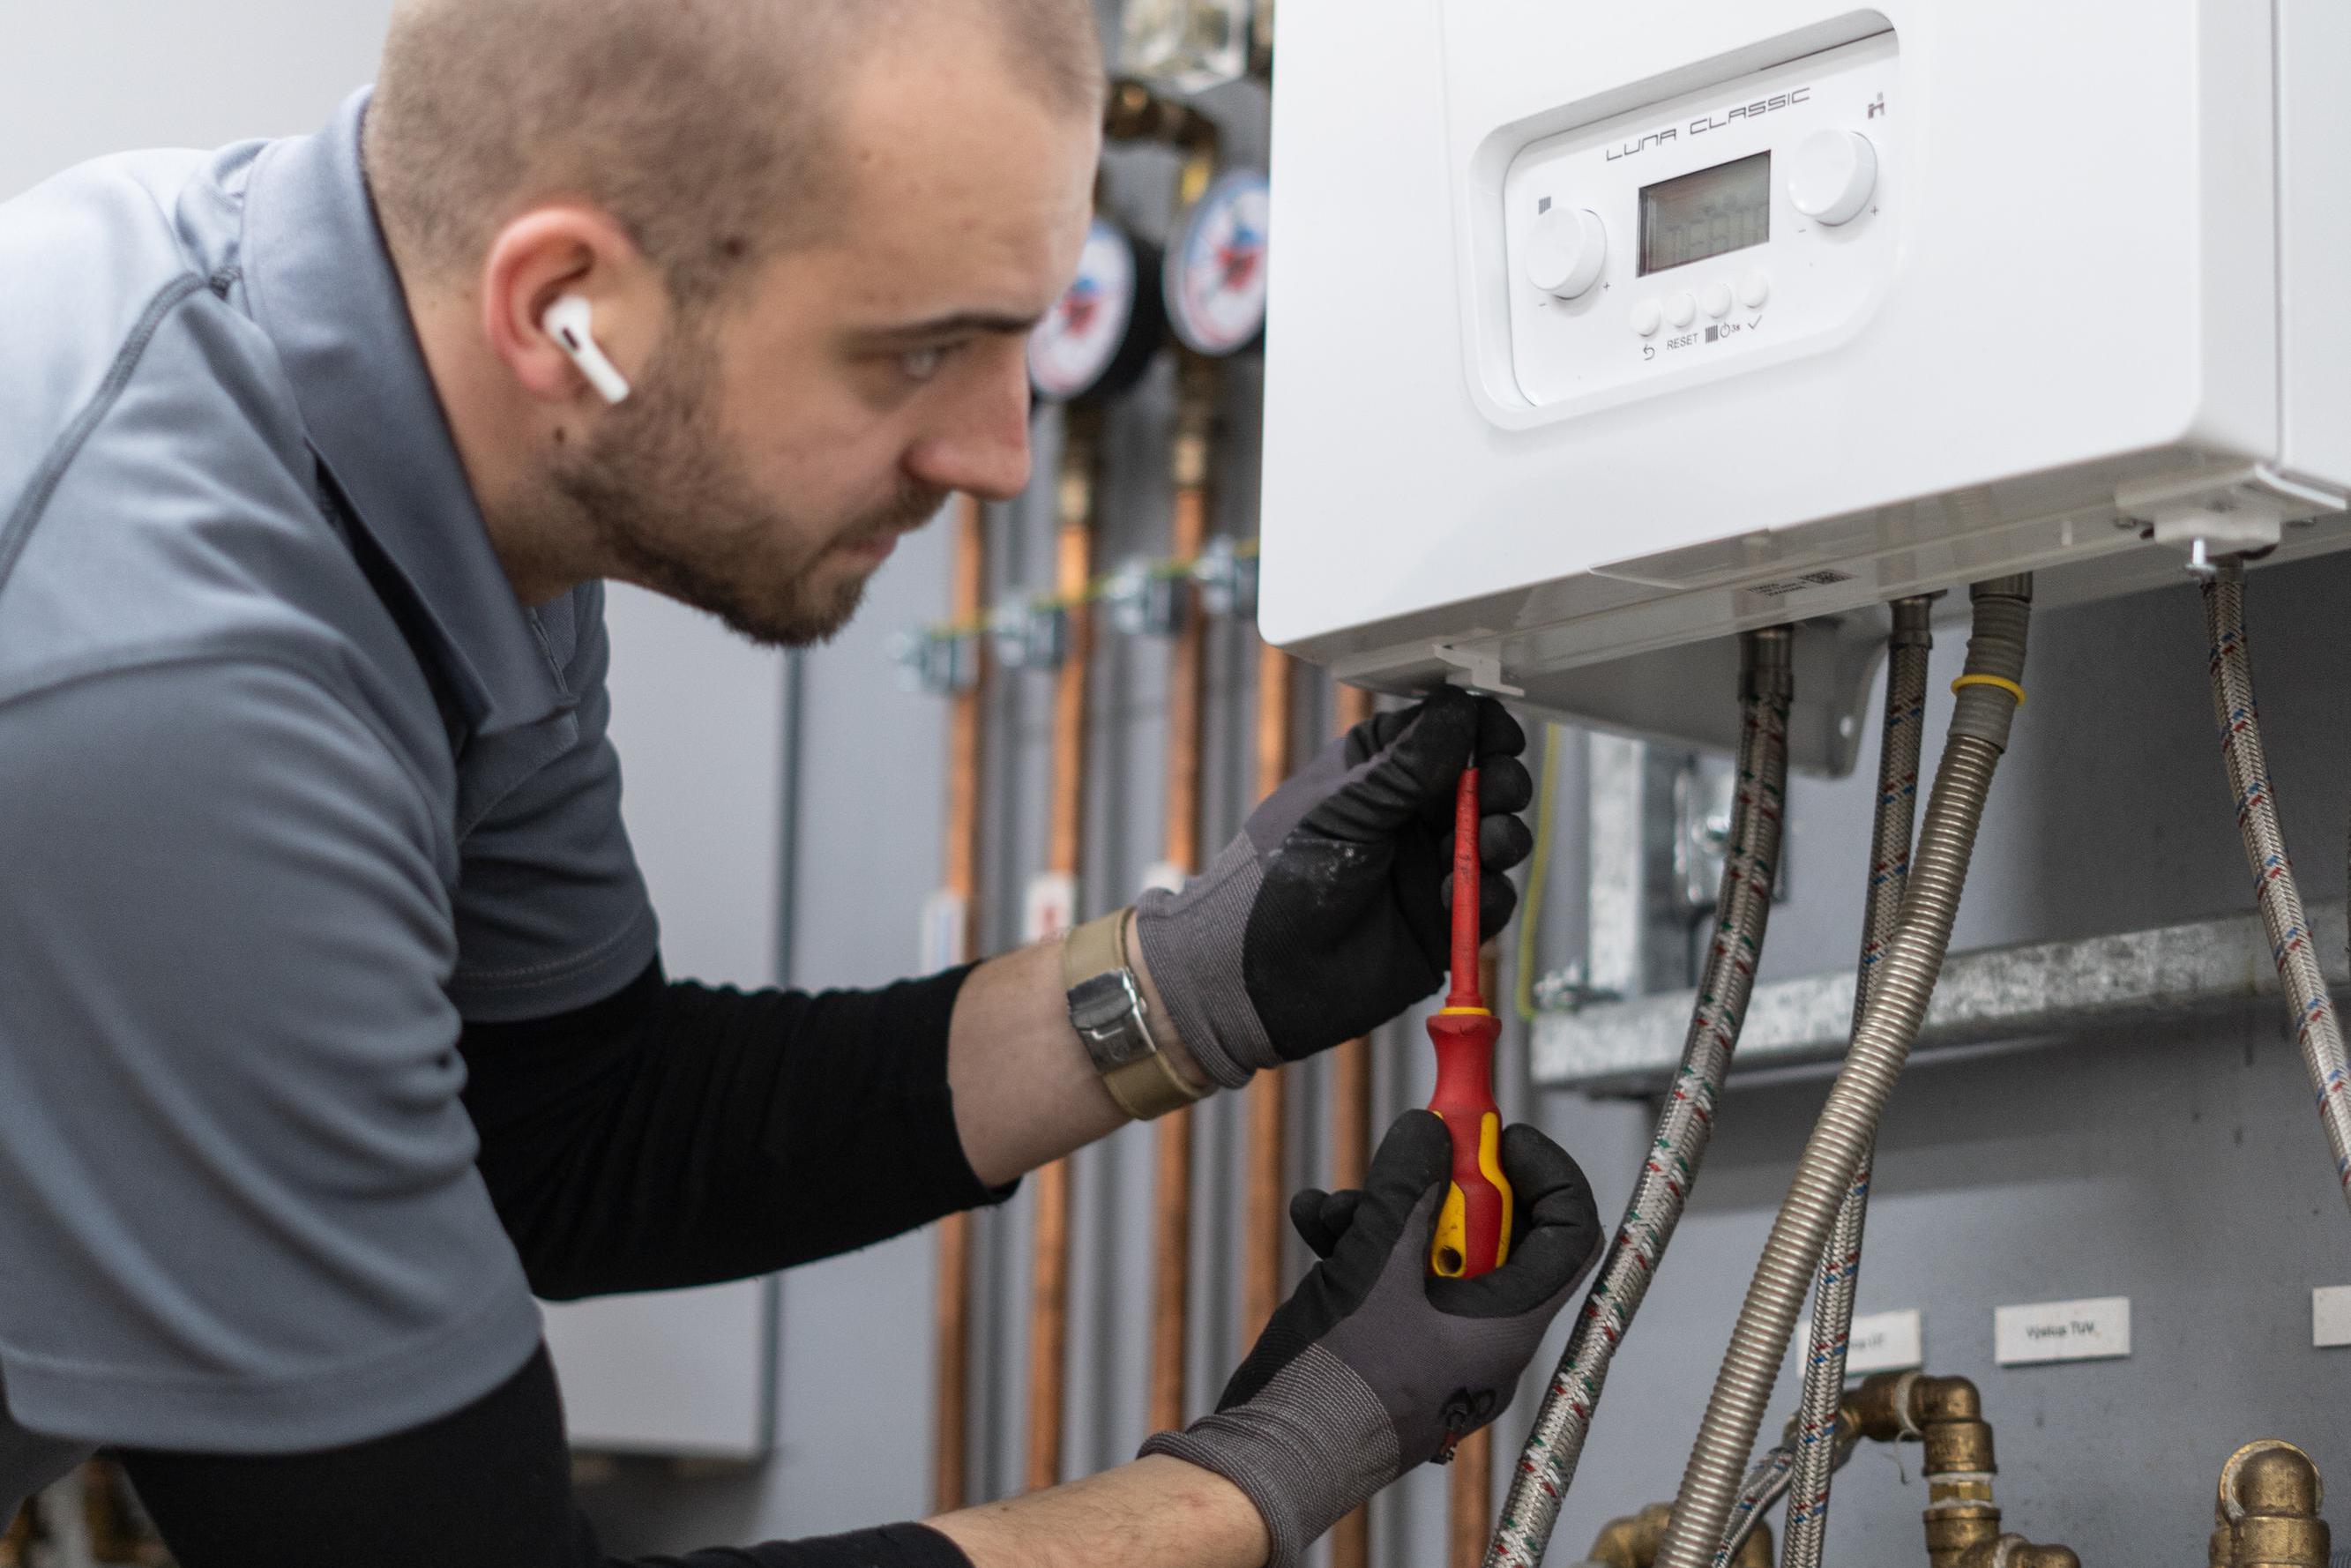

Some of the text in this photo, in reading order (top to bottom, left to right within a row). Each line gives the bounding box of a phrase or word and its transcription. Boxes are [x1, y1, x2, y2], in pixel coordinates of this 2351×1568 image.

[1606, 87, 1810, 161] LUNA CLASSIC
[1667, 332, 1698, 350] RESET
